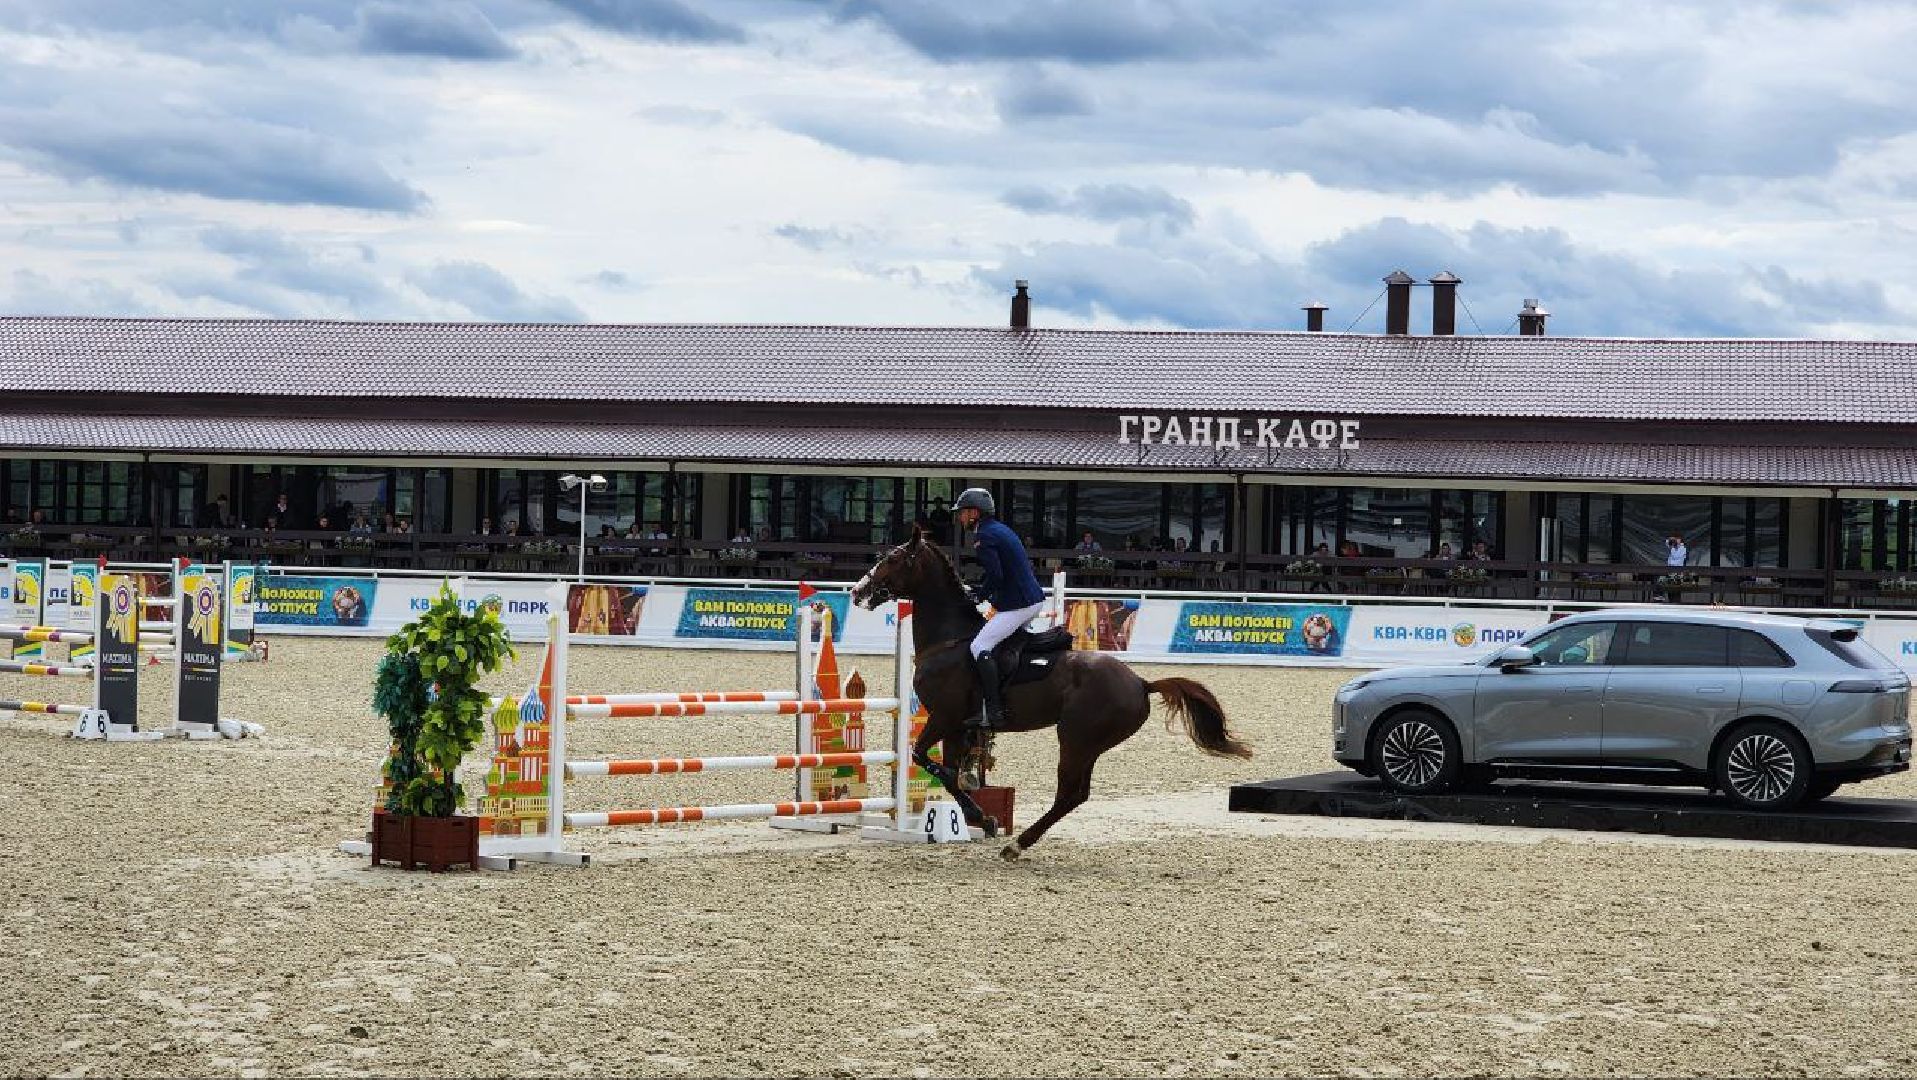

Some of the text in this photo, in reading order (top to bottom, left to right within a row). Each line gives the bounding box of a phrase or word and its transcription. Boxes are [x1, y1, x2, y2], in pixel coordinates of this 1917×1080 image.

[1118, 415, 1360, 450] ГРАНД-КАФЕ
[261, 587, 324, 600] ПОЛОЖЕН
[253, 601, 318, 615] ВАОТПУСК
[508, 601, 549, 615] ПАРК
[695, 600, 793, 615] ВАМ ПОЛОЖЕН
[699, 614, 787, 630] АКВАОТПУСК
[1189, 614, 1292, 630] ВАМ ПОЛОЖЕН
[1195, 629, 1286, 644] АКВАОТПУСК
[79, 713, 89, 733] 6
[97, 713, 106, 733] 6
[925, 807, 937, 832] 8
[950, 809, 960, 835] 8
